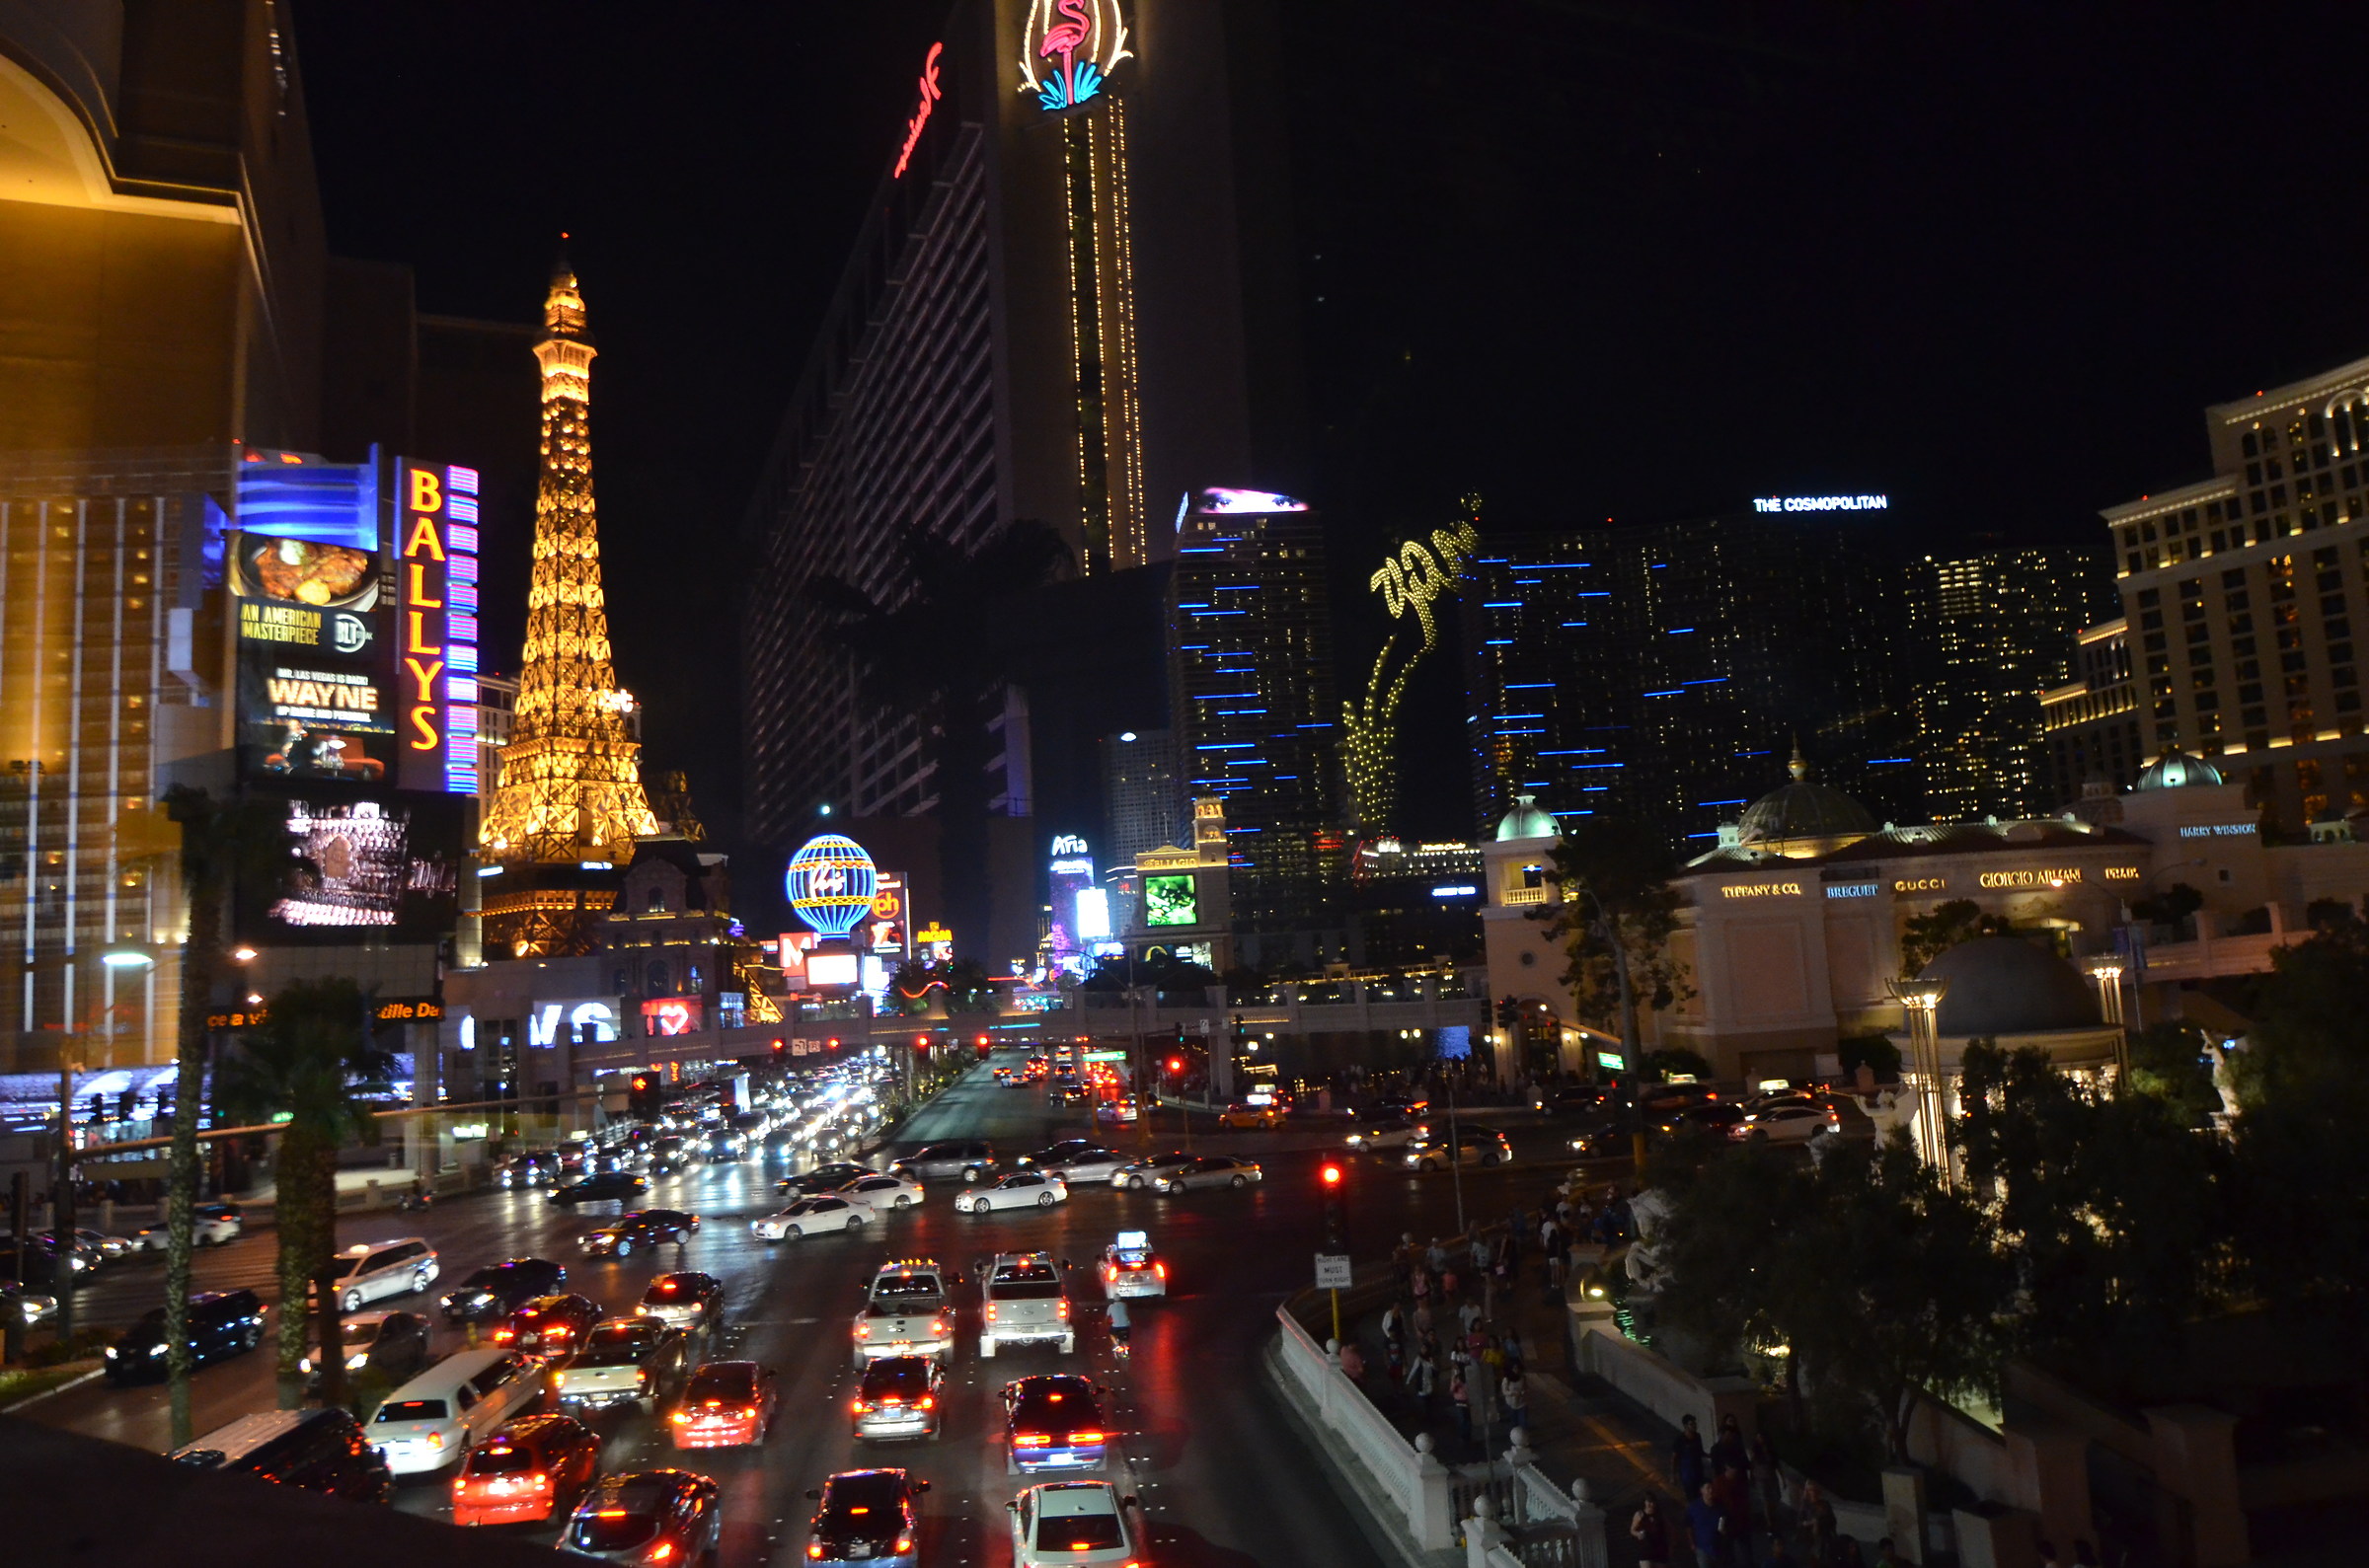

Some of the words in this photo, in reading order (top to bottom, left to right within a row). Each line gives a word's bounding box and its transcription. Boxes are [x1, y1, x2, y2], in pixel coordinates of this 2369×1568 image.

[1753, 498, 1782, 512] THE
[1784, 495, 1887, 511] COSMOPOLITAN
[241, 604, 259, 622] AN
[263, 606, 322, 629] AMERICAN
[241, 621, 320, 645] MASTERPIECE
[277, 667, 294, 679] MR.
[294, 669, 311, 681] LAS
[311, 671, 336, 683] VEGAS
[336, 673, 345, 683] IS
[267, 678, 379, 710] WAYNE
[2179, 826, 2211, 838] HARRY
[2213, 823, 2255, 836] WINSTON
[1051, 835, 1088, 856] Aria
[1894, 878, 1946, 892] GUCCI
[1979, 871, 2033, 889] GIORGIO
[1721, 885, 1771, 899] TIFFANY
[1772, 884, 1781, 896] &
[1826, 884, 1878, 899] BREGUET
[917, 930, 953, 943] MGM
